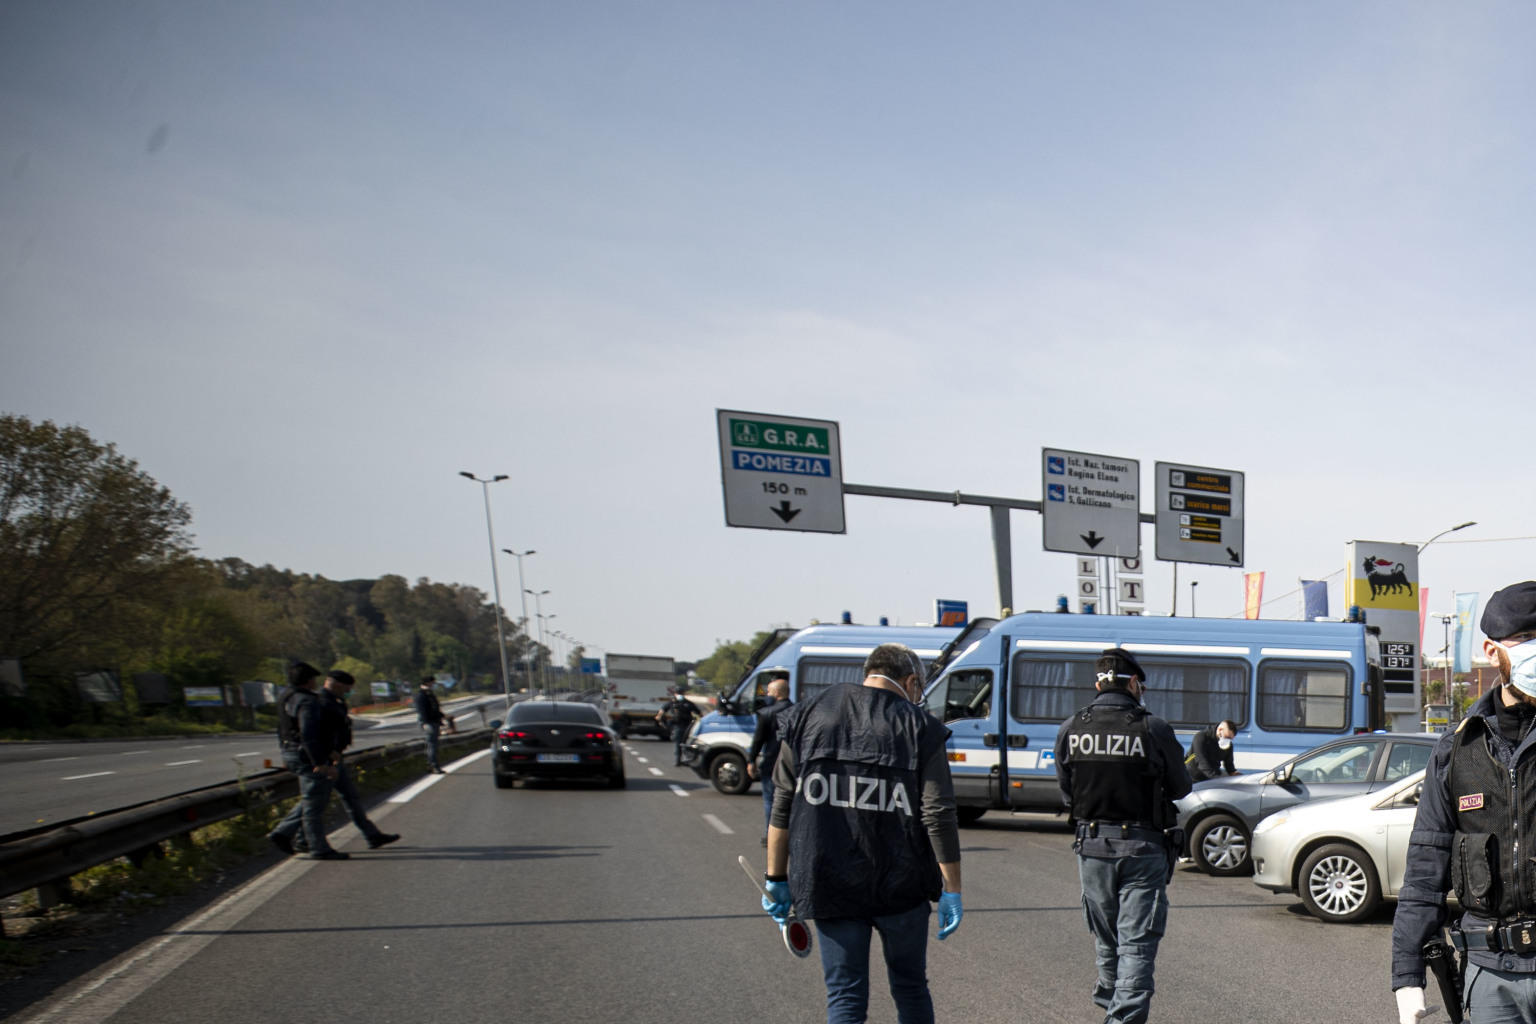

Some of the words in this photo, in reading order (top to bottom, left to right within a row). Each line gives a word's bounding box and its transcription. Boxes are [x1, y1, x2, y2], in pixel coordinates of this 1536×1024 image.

[763, 428, 825, 449] G.R.A.
[737, 453, 825, 475] POMEZIA
[762, 482, 789, 494] 150
[794, 487, 807, 496] m
[1069, 734, 1145, 757] POLIZIA
